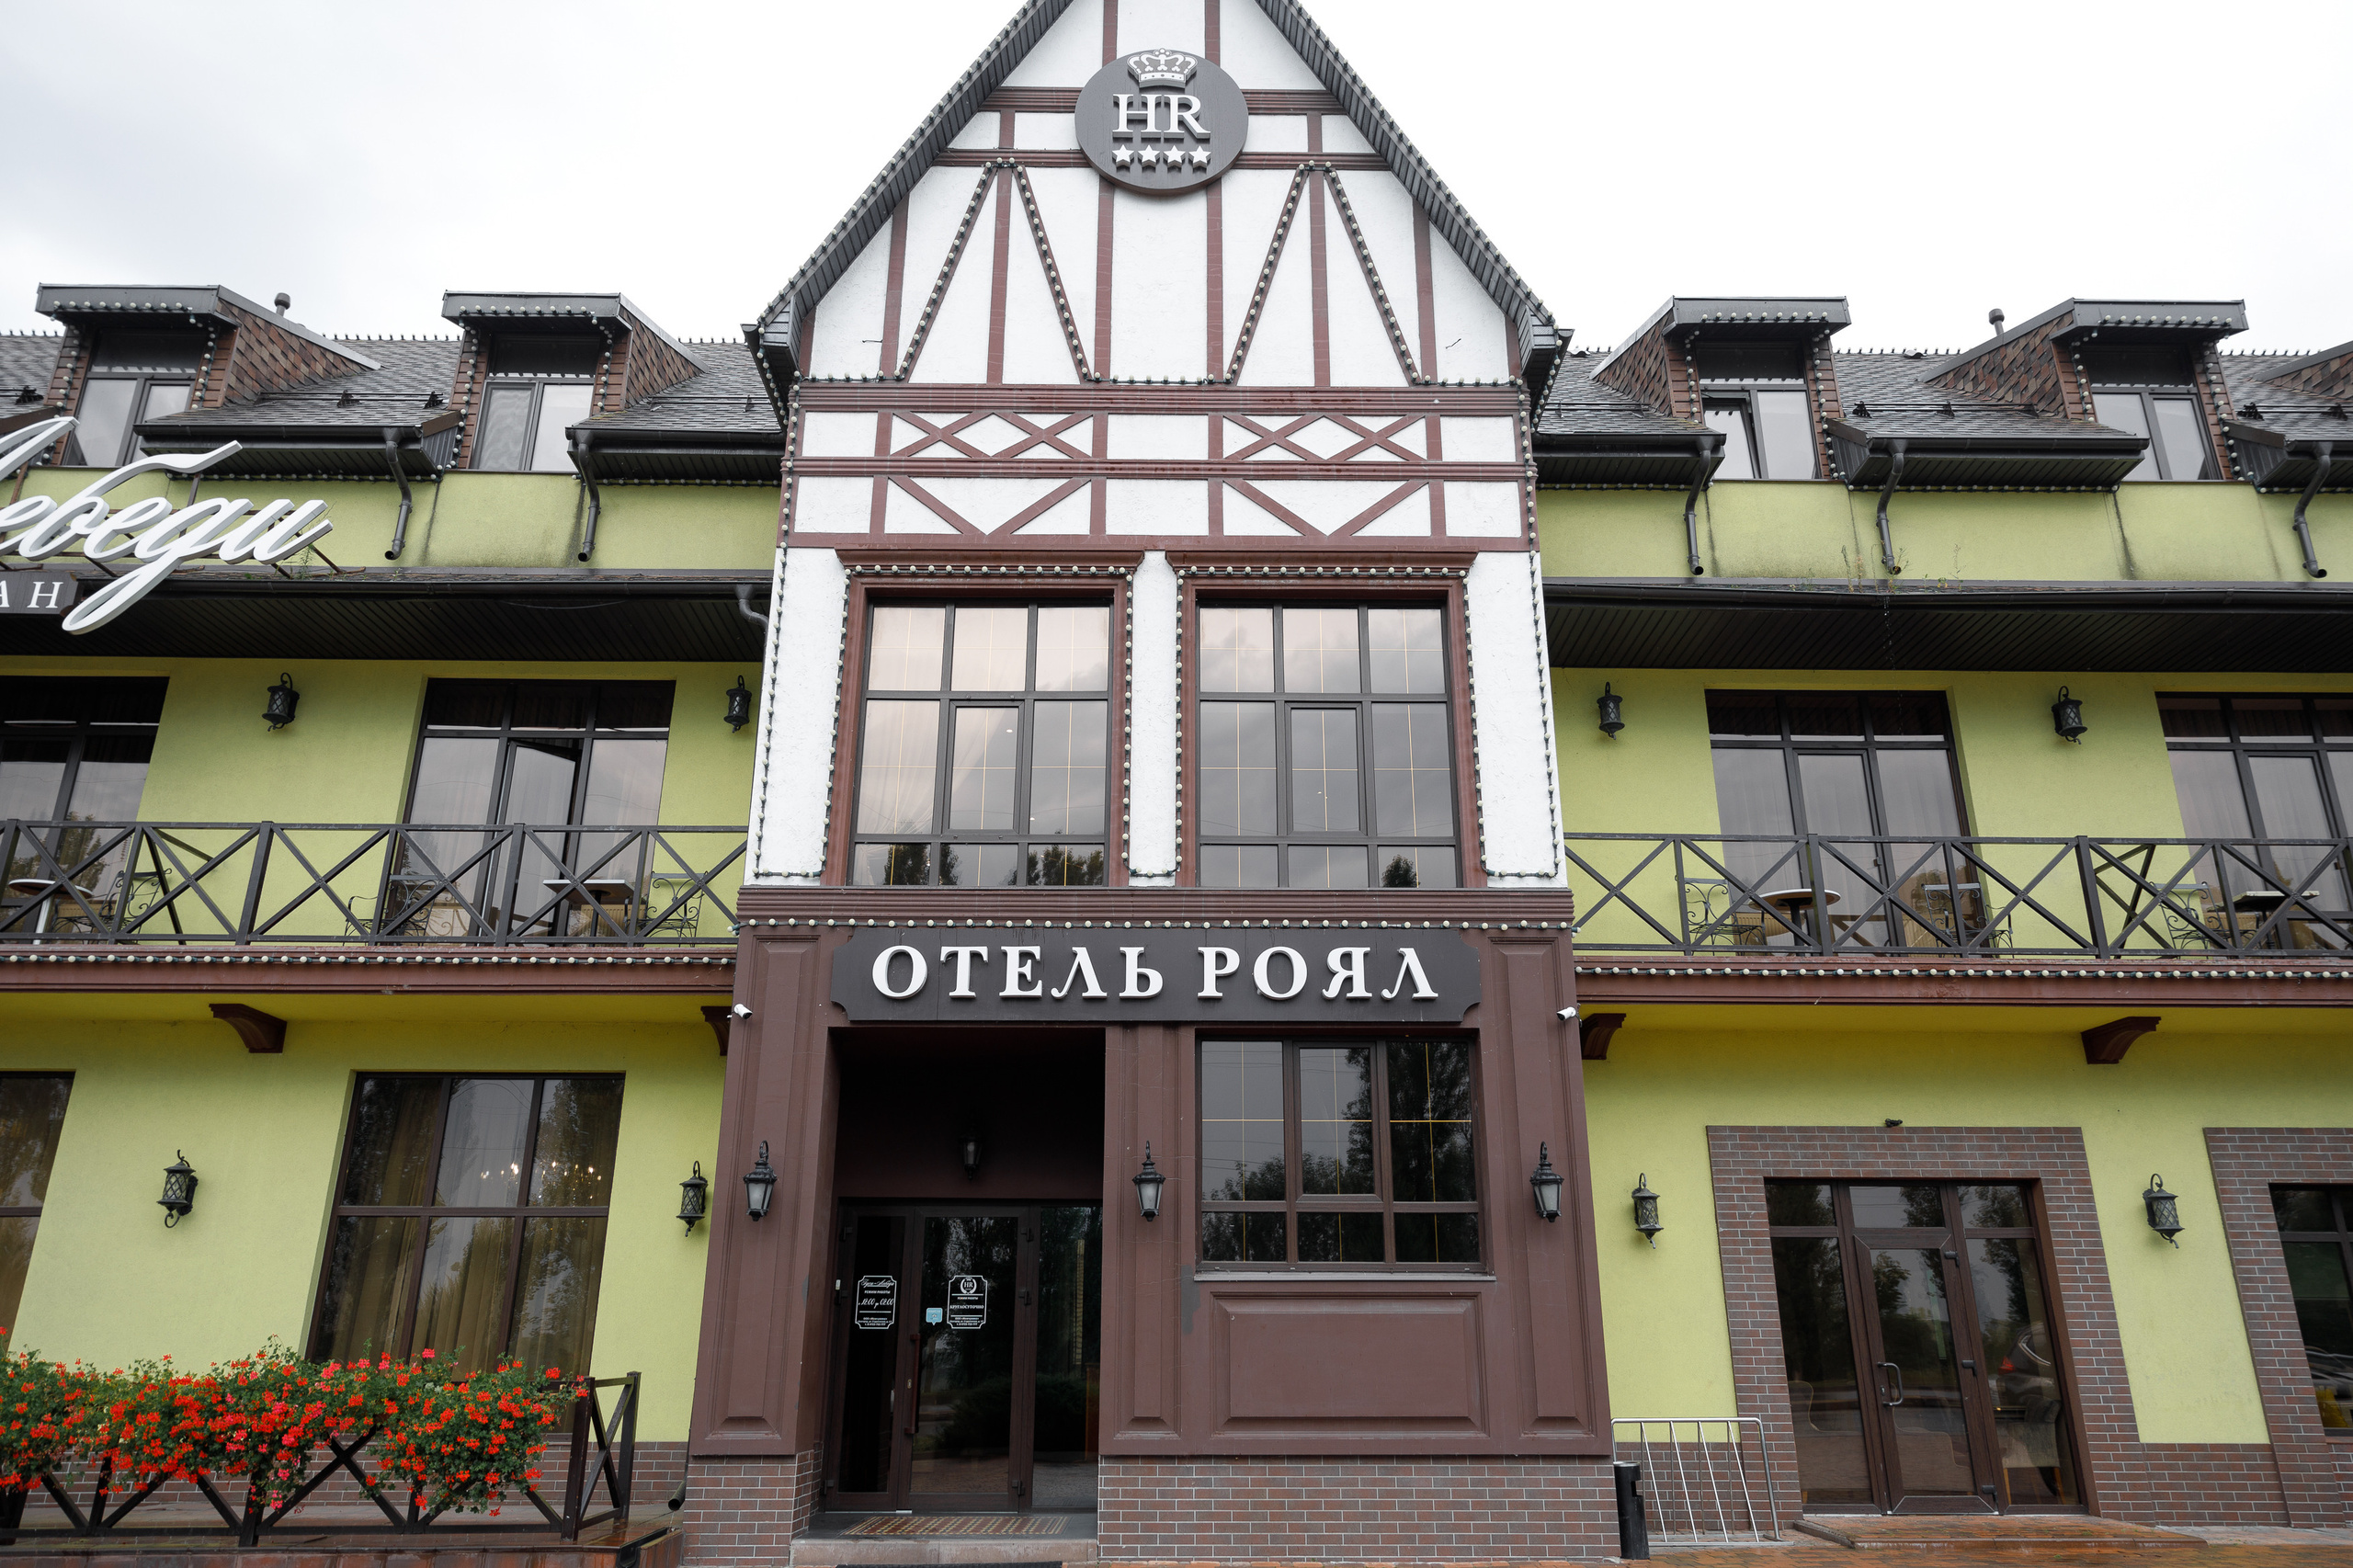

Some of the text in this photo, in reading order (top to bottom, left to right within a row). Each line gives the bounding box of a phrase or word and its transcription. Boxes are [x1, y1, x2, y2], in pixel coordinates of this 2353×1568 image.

[1112, 94, 1211, 139] HR
[871, 945, 1438, 1001] ОТЕЛЬ РОЯЛ
